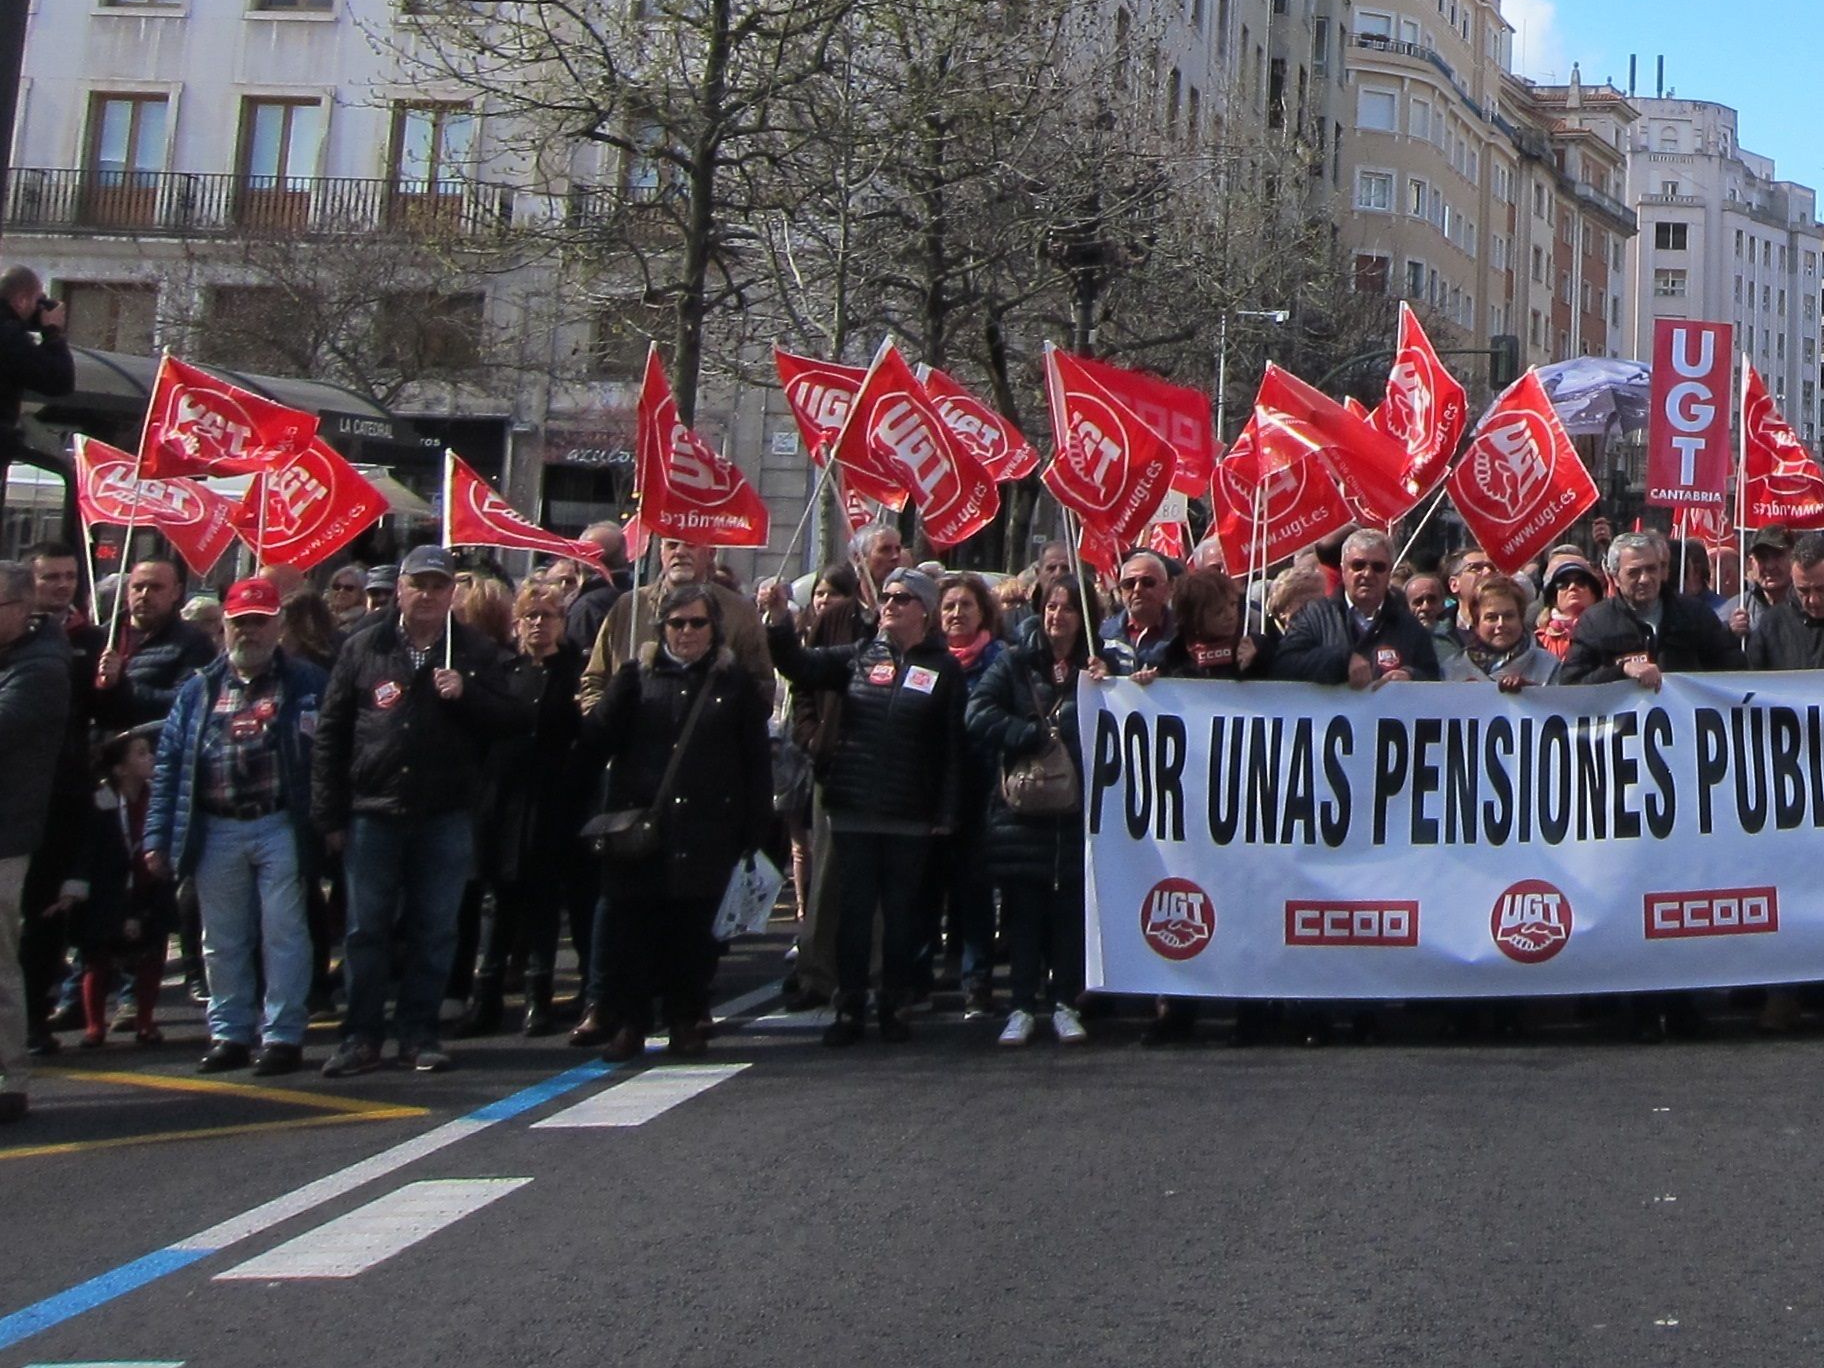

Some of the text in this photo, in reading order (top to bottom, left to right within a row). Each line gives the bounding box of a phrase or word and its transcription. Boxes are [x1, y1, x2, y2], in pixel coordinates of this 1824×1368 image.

[1664, 327, 1716, 487] UGT
[340, 418, 351, 433] LA
[876, 399, 951, 502] UGT
[1487, 418, 1549, 500] UGT
[1649, 487, 1722, 503] CANTABRIA
[1502, 486, 1577, 556] www.ugt.es
[1198, 648, 1233, 660] CCOO
[1090, 708, 1187, 842] POR
[1207, 714, 1353, 848] UNAS
[1371, 706, 1675, 847] PENSIONES
[1152, 890, 1204, 924] UGT
[1293, 909, 1409, 938] CCOO
[1500, 892, 1564, 928] UGT
[1653, 894, 1768, 930] CCOO
